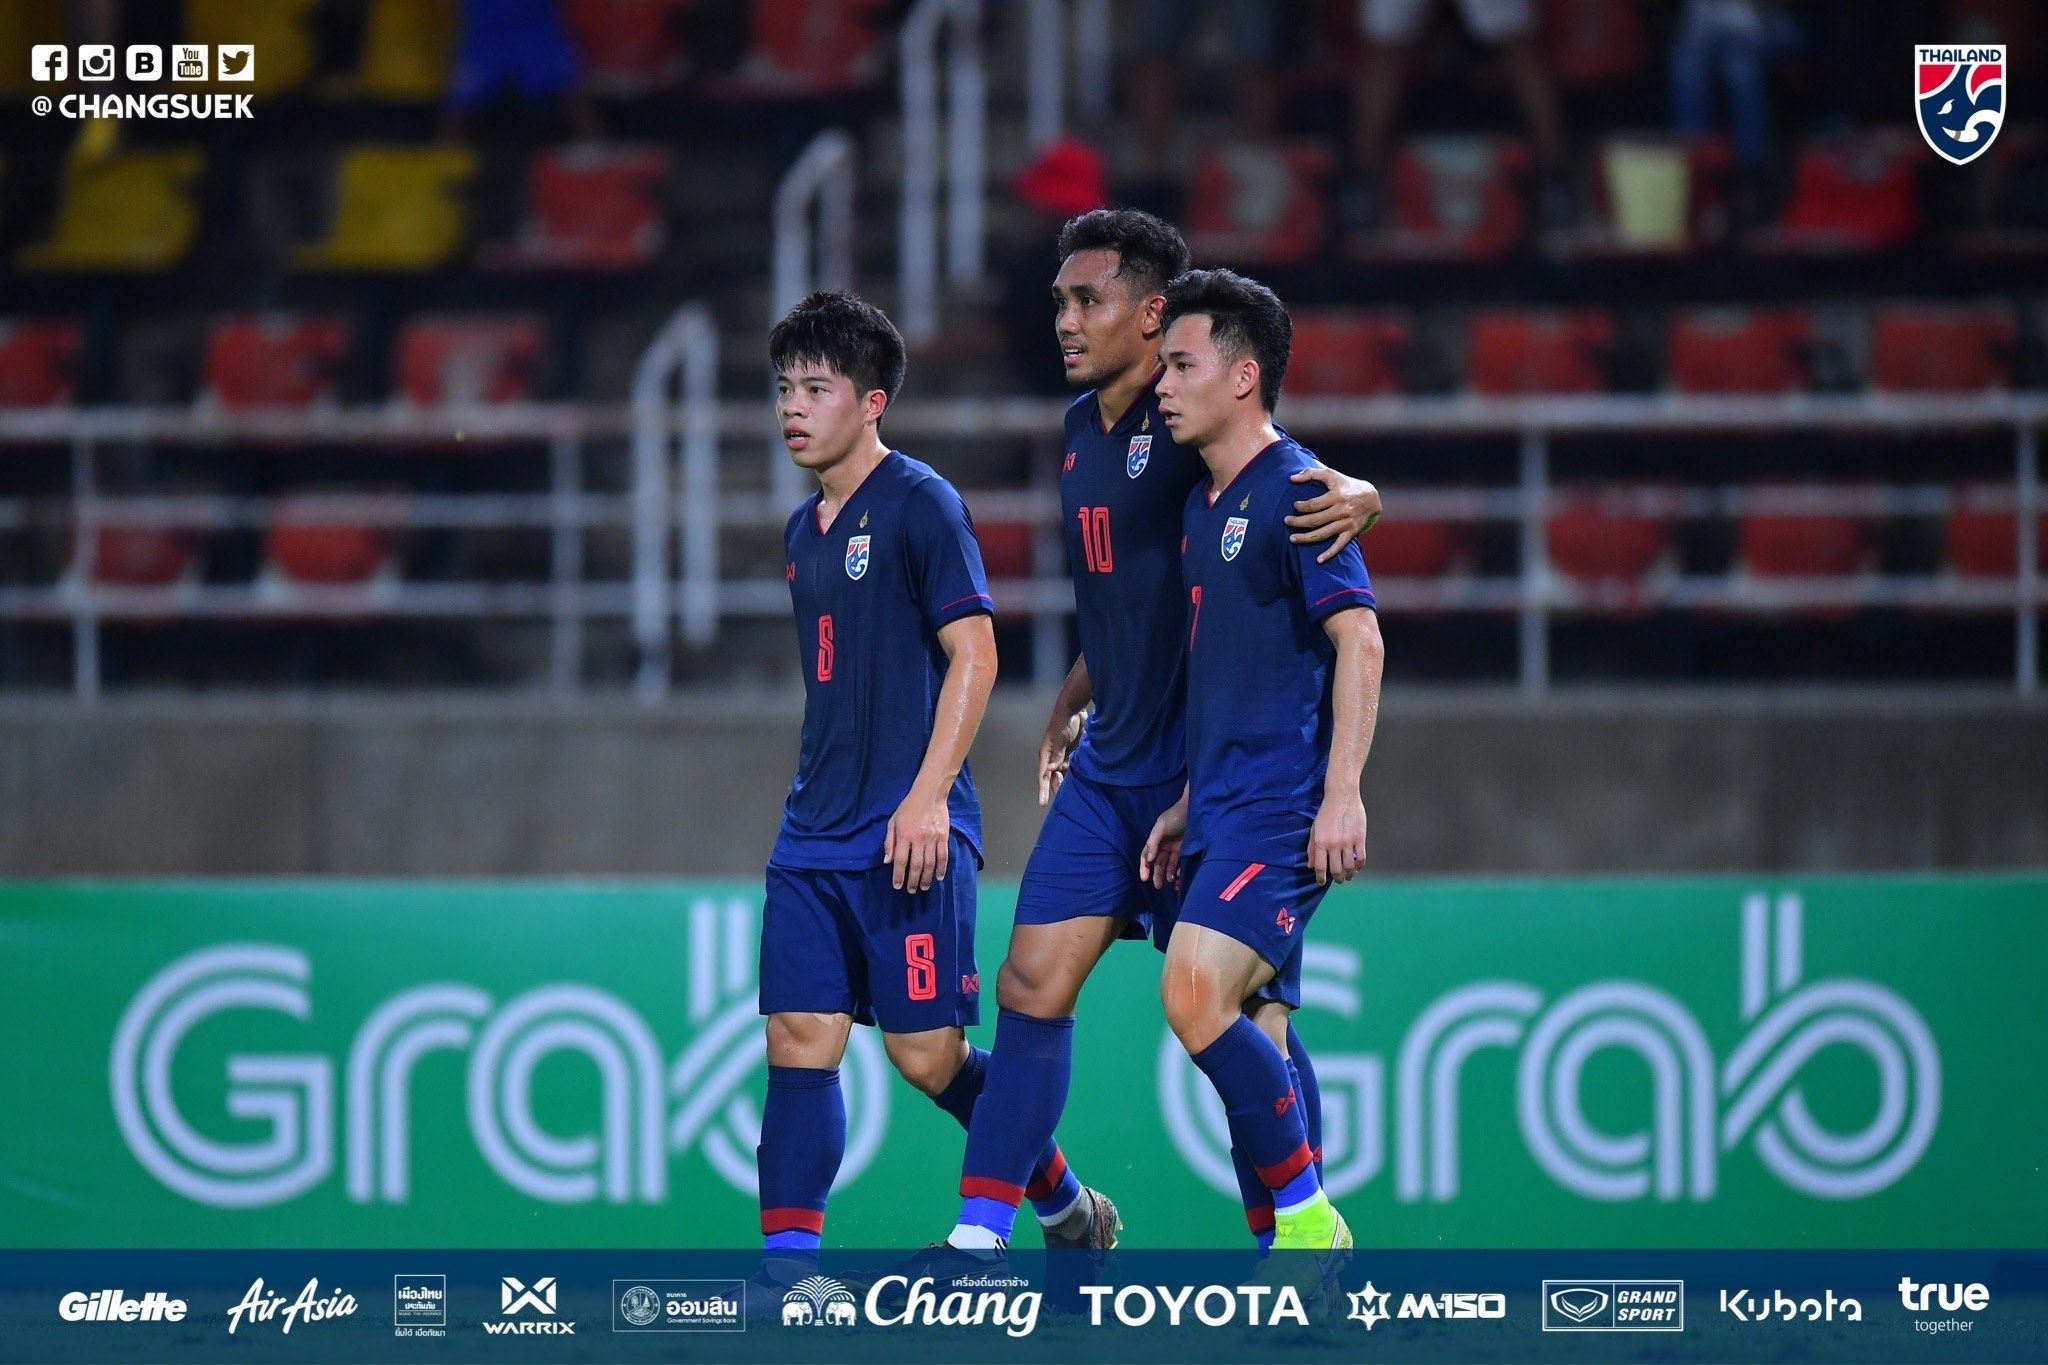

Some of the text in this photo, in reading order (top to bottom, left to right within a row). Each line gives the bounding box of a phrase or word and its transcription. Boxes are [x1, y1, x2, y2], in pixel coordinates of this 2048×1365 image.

[1078, 506, 1114, 573] 10
[817, 614, 834, 682] 8
[906, 933, 937, 1001] 8
[109, 897, 890, 1208] Grab
[1157, 894, 1941, 1203] Grab
